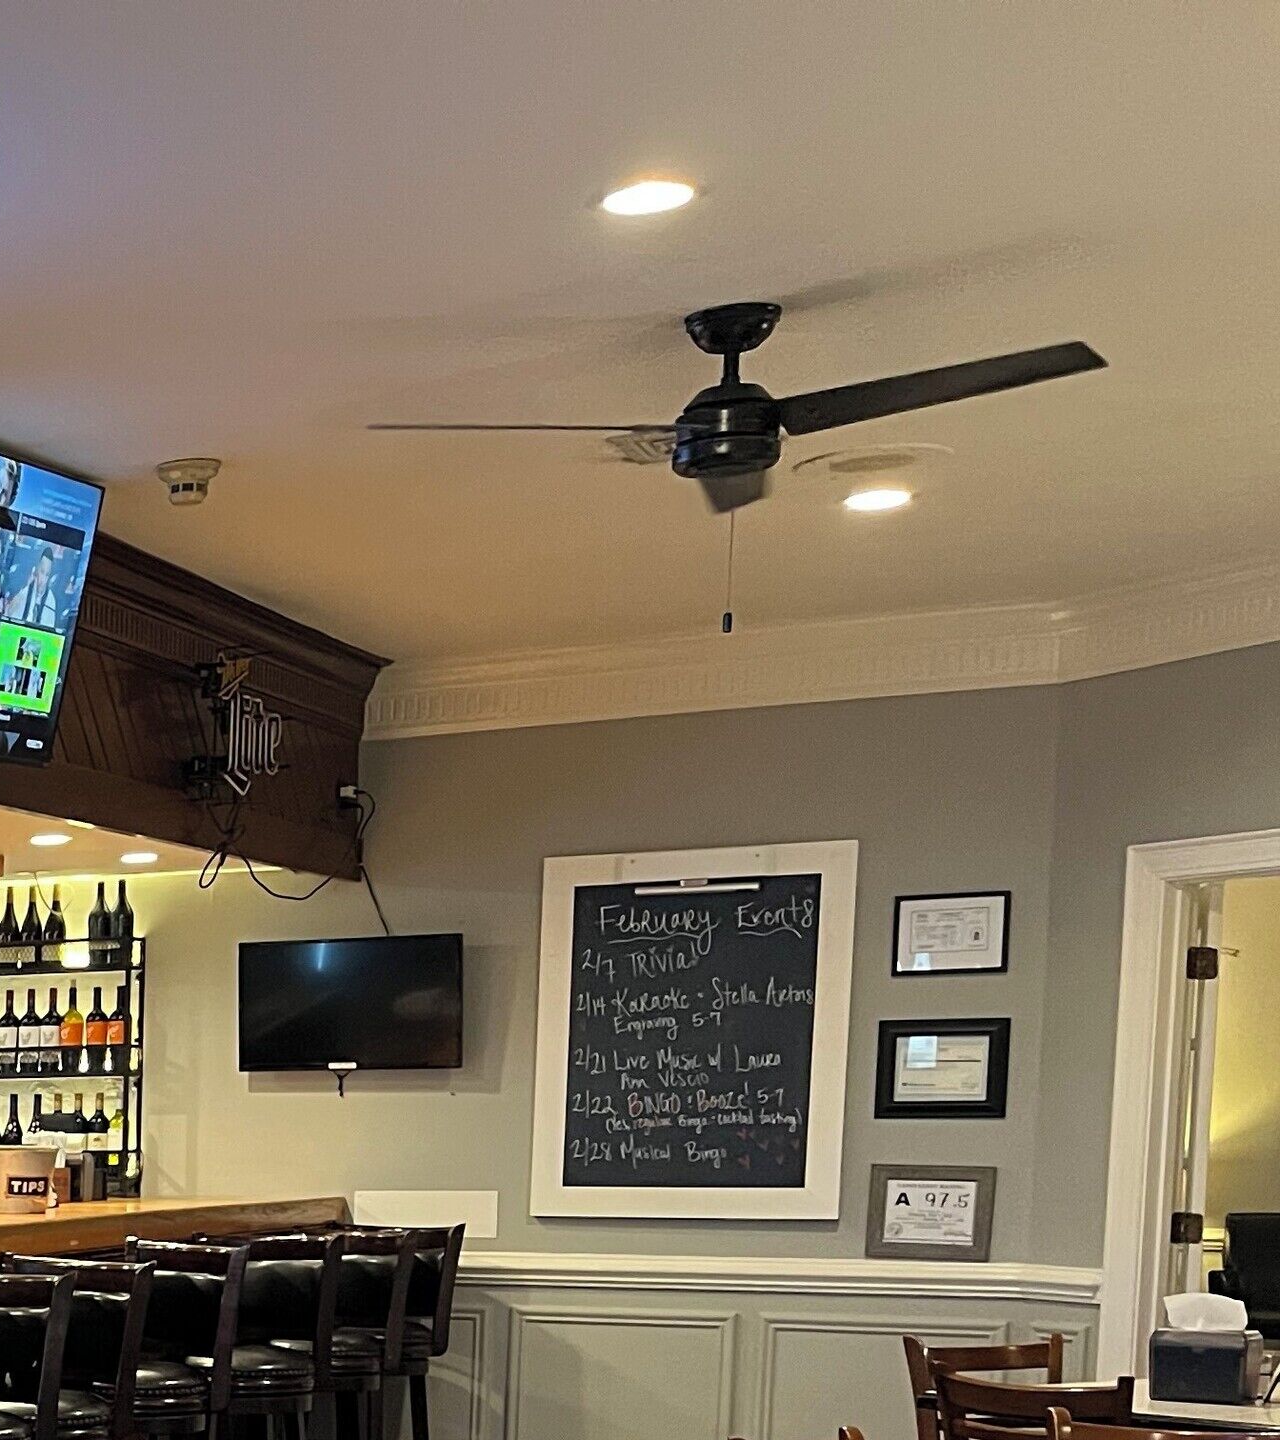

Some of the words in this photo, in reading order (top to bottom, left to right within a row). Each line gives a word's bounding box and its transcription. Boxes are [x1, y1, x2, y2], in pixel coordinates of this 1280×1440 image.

[582, 949, 616, 984] 2/7
[576, 991, 607, 1017] 2/14
[711, 976, 760, 1011] Stella
[575, 1043, 607, 1075] 2/21
[614, 1050, 650, 1072] Live
[656, 1046, 701, 1071] Music
[10, 1180, 46, 1193] TIPS
[895, 1192, 911, 1206] A
[925, 1192, 971, 1209] 97.5
